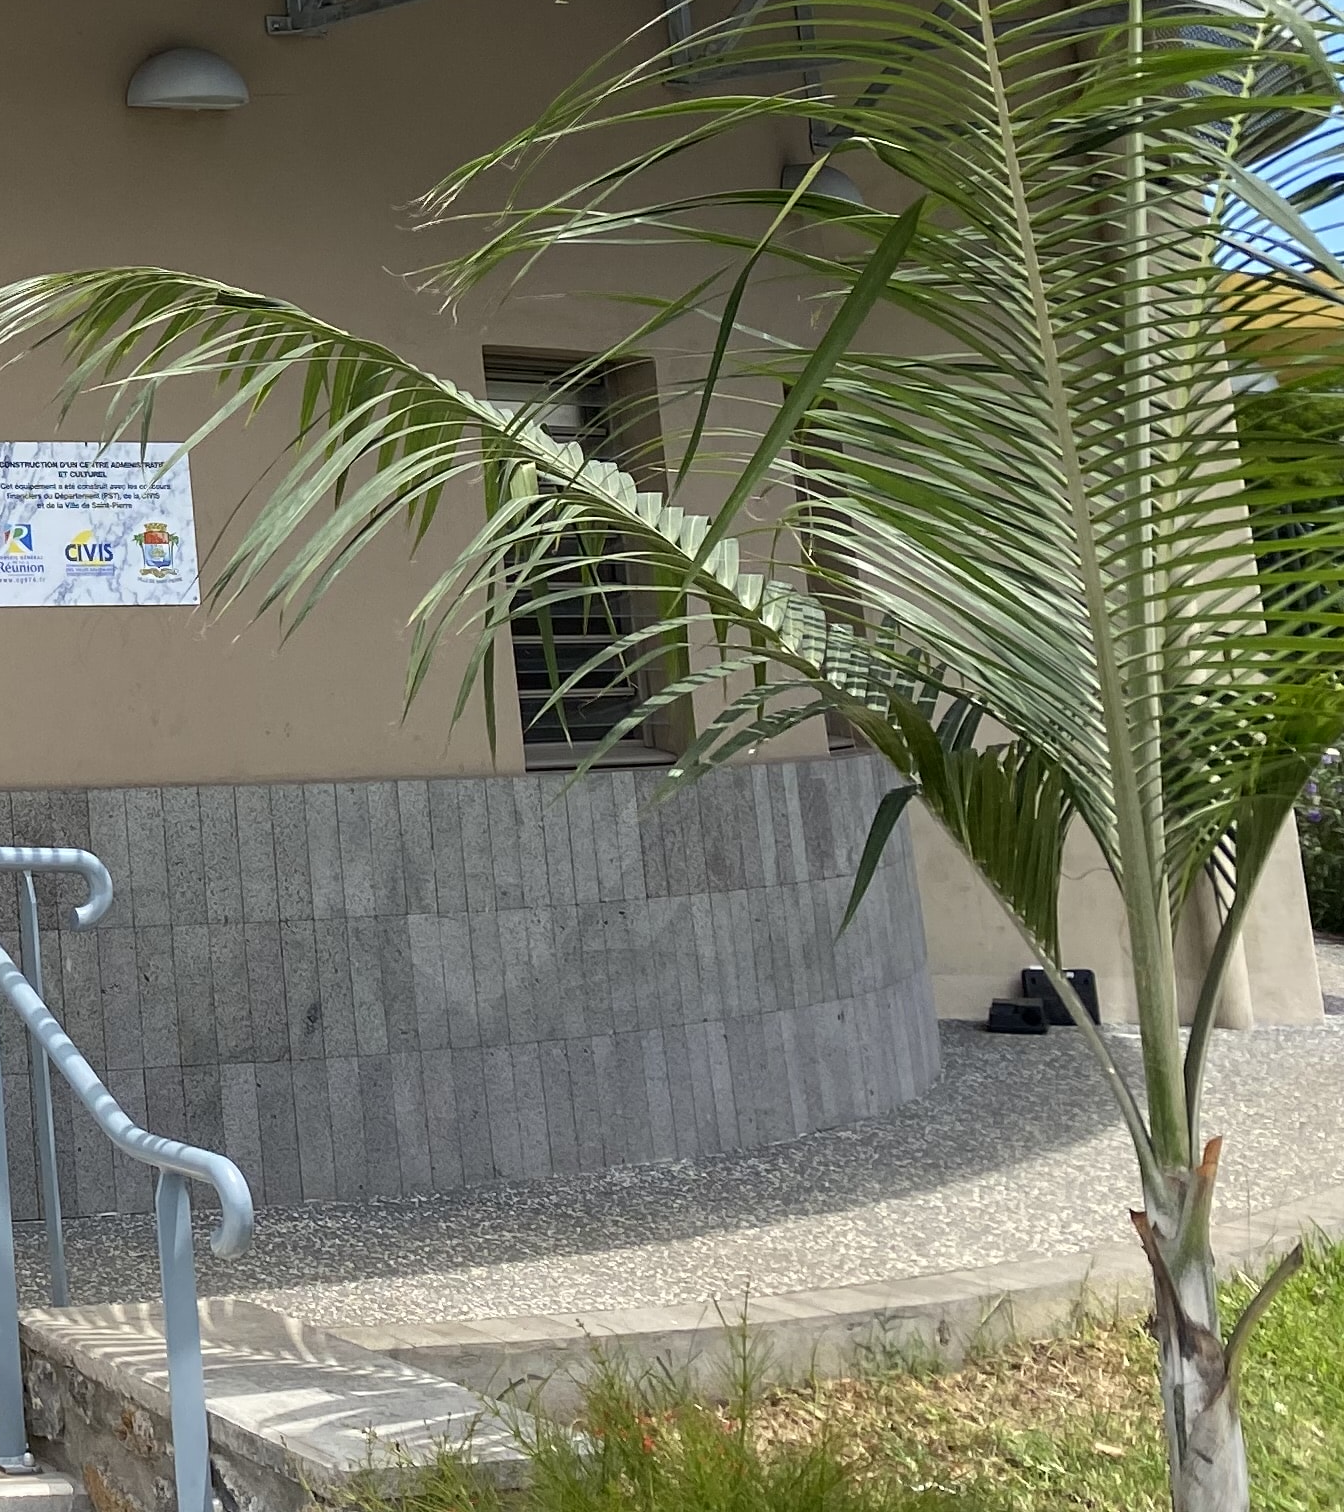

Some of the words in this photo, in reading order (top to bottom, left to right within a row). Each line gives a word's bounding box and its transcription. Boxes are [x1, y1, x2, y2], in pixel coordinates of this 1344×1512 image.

[0, 461, 58, 469] CONSTRUCTION
[59, 461, 78, 469] D'UN
[15, 483, 56, 491] équipement
[92, 501, 133, 509] Saint-Pierre
[65, 543, 114, 562] CIVIS
